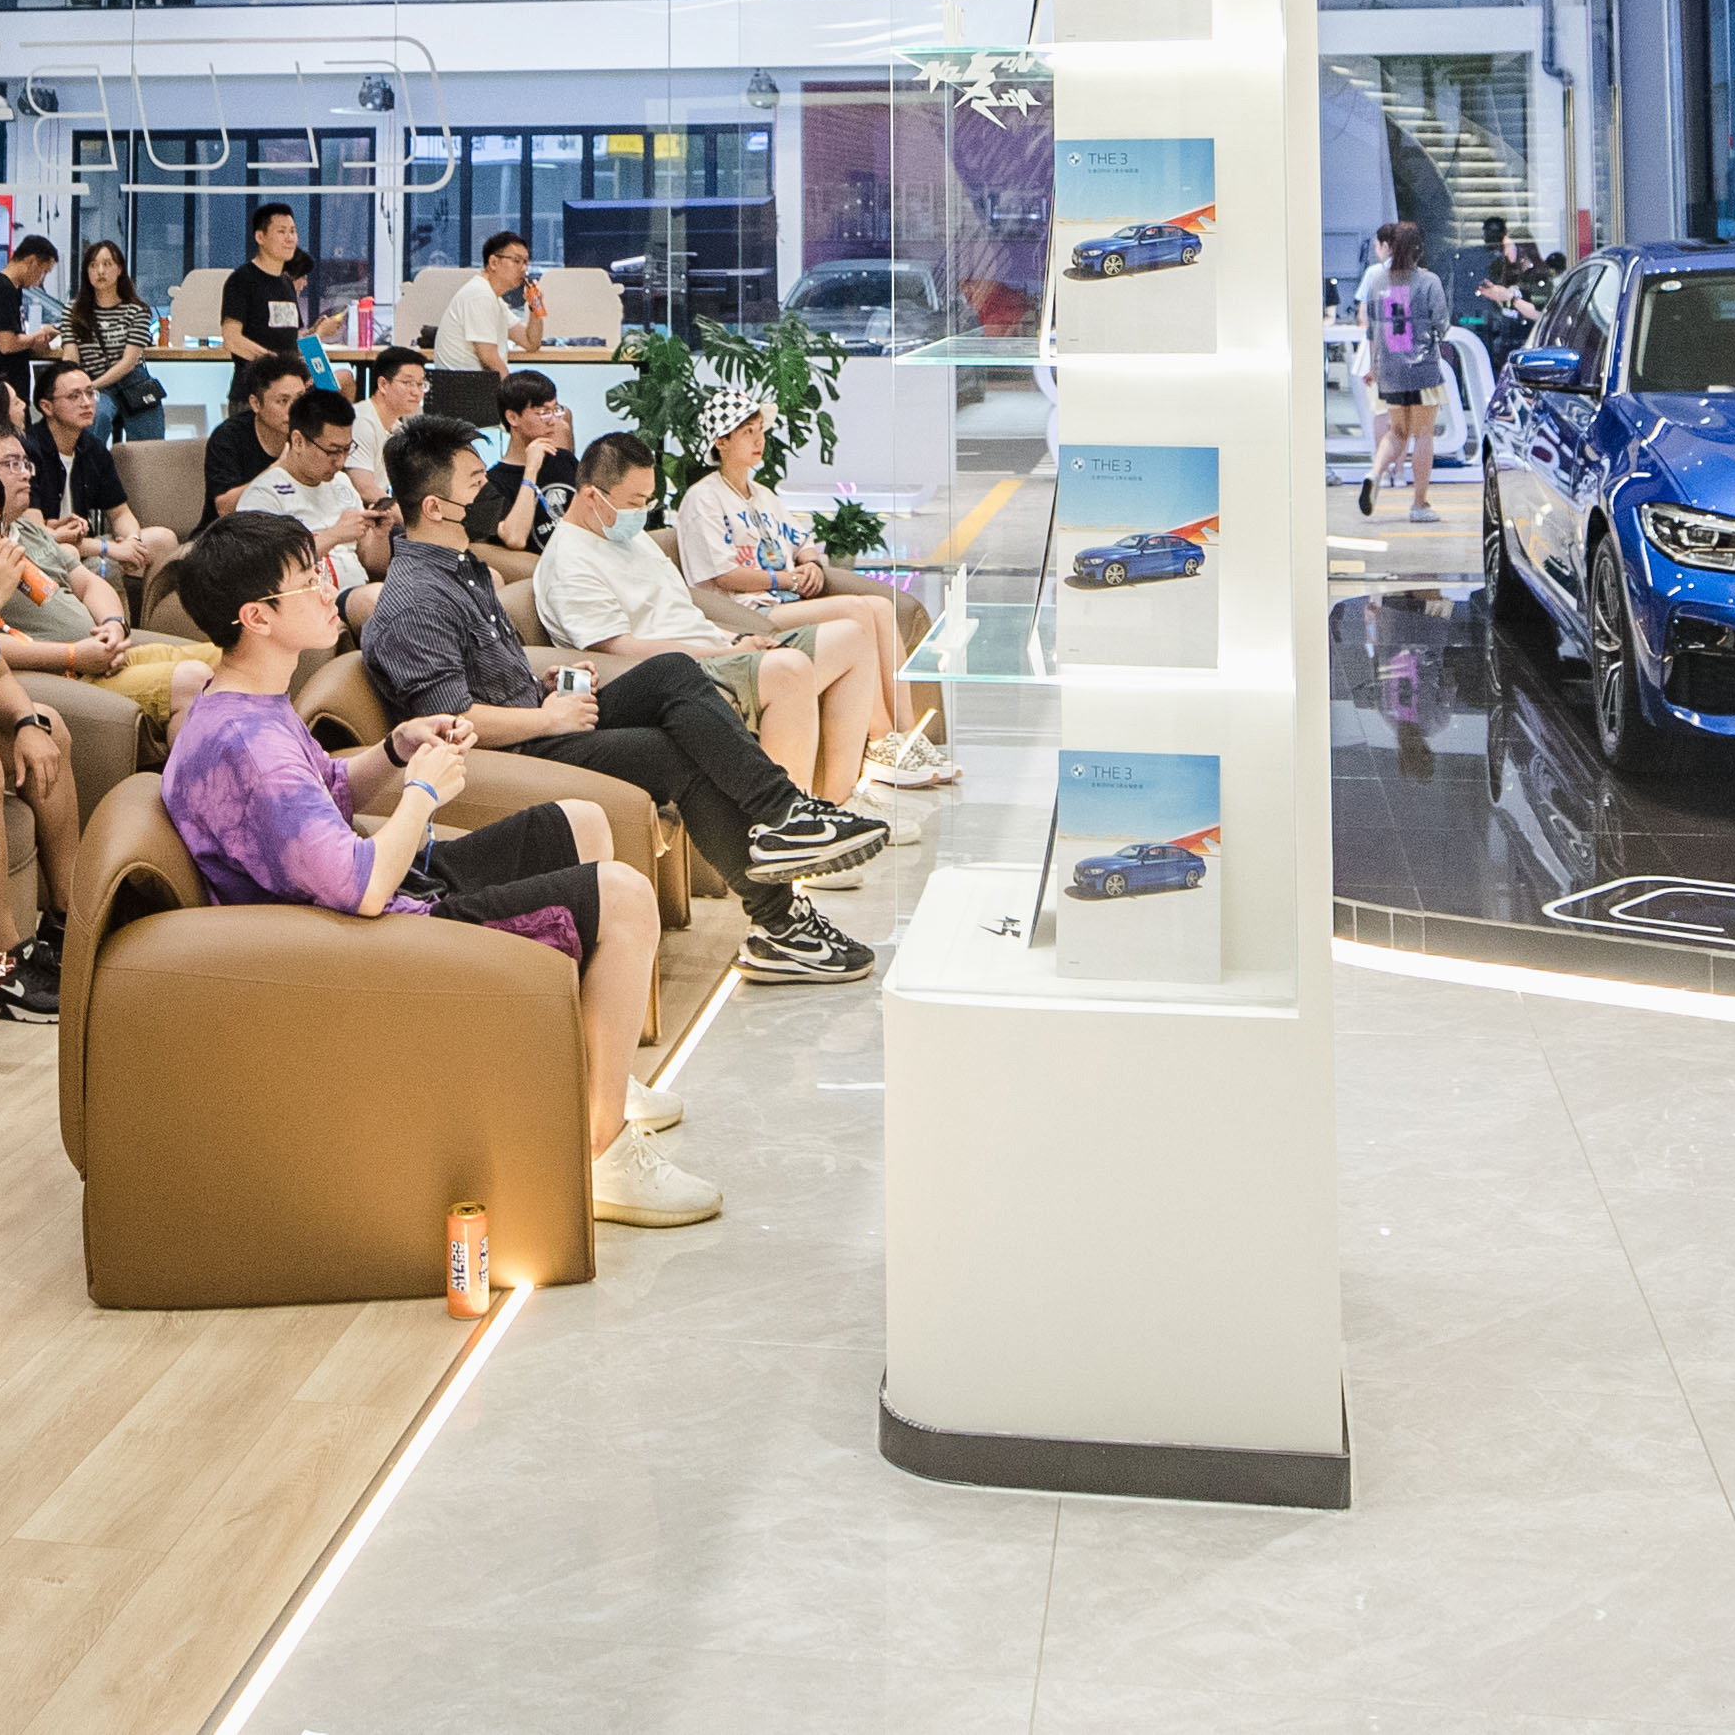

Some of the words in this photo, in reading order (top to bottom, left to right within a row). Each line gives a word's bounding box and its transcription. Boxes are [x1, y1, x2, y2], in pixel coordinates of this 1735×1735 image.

[1087, 153, 1116, 165] THE
[1121, 153, 1128, 165] 3
[1091, 459, 1120, 471] THE
[1124, 460, 1132, 472] 3
[1091, 766, 1120, 779] THE
[1124, 767, 1132, 780] 3
